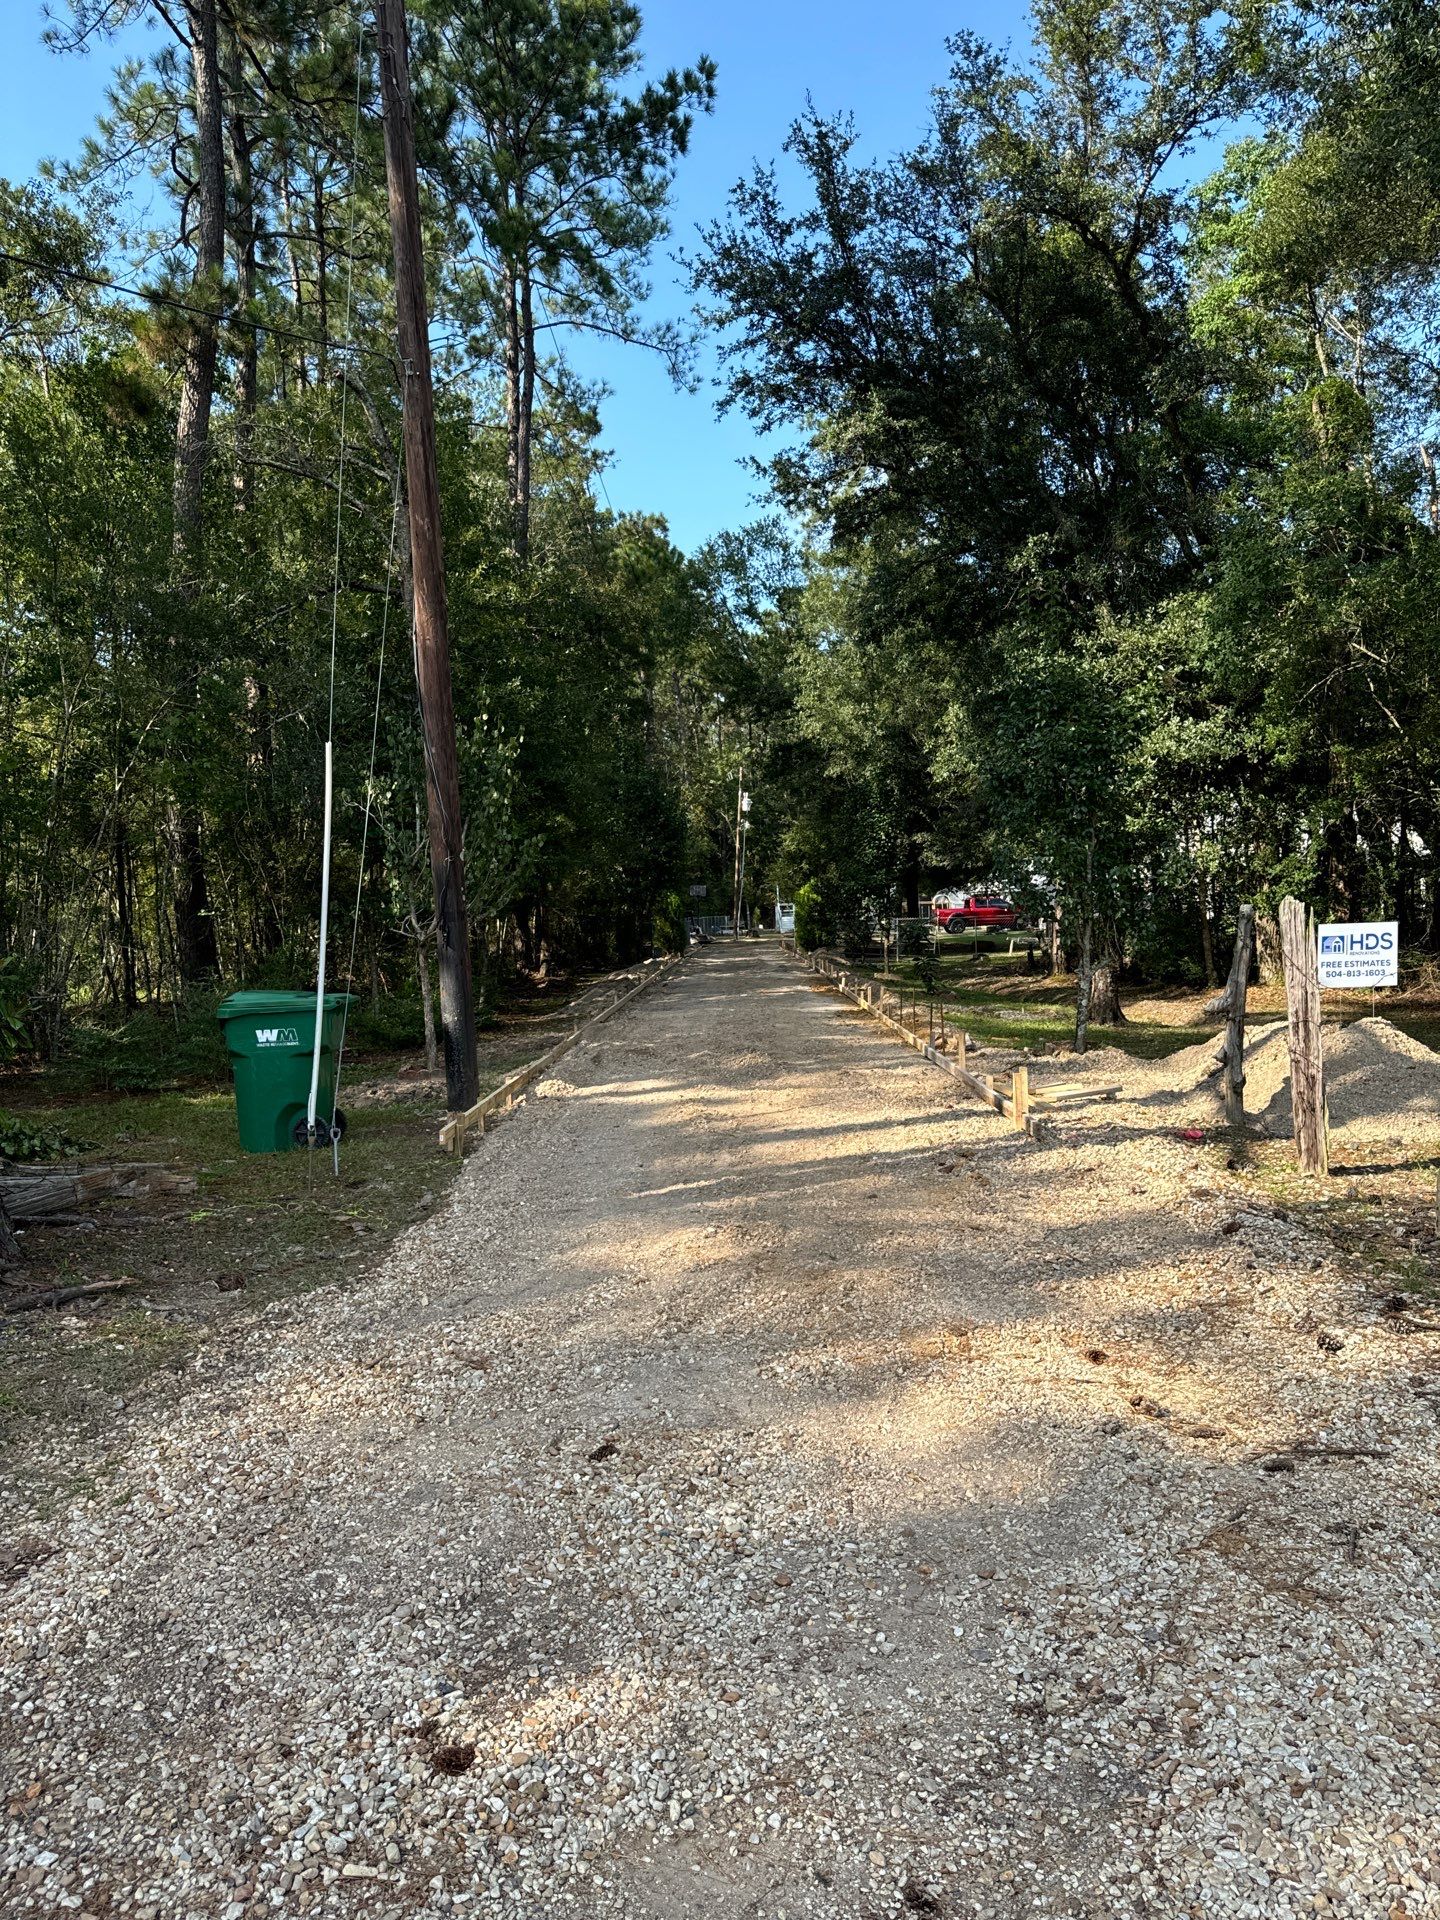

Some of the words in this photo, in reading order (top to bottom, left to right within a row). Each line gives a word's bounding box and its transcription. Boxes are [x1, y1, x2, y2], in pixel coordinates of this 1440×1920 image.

[1350, 932, 1393, 950] HDS
[1344, 960, 1391, 968] ESTIMATES
[1325, 969, 1386, 977] 504-813-1603
[255, 1028, 299, 1043] WM
